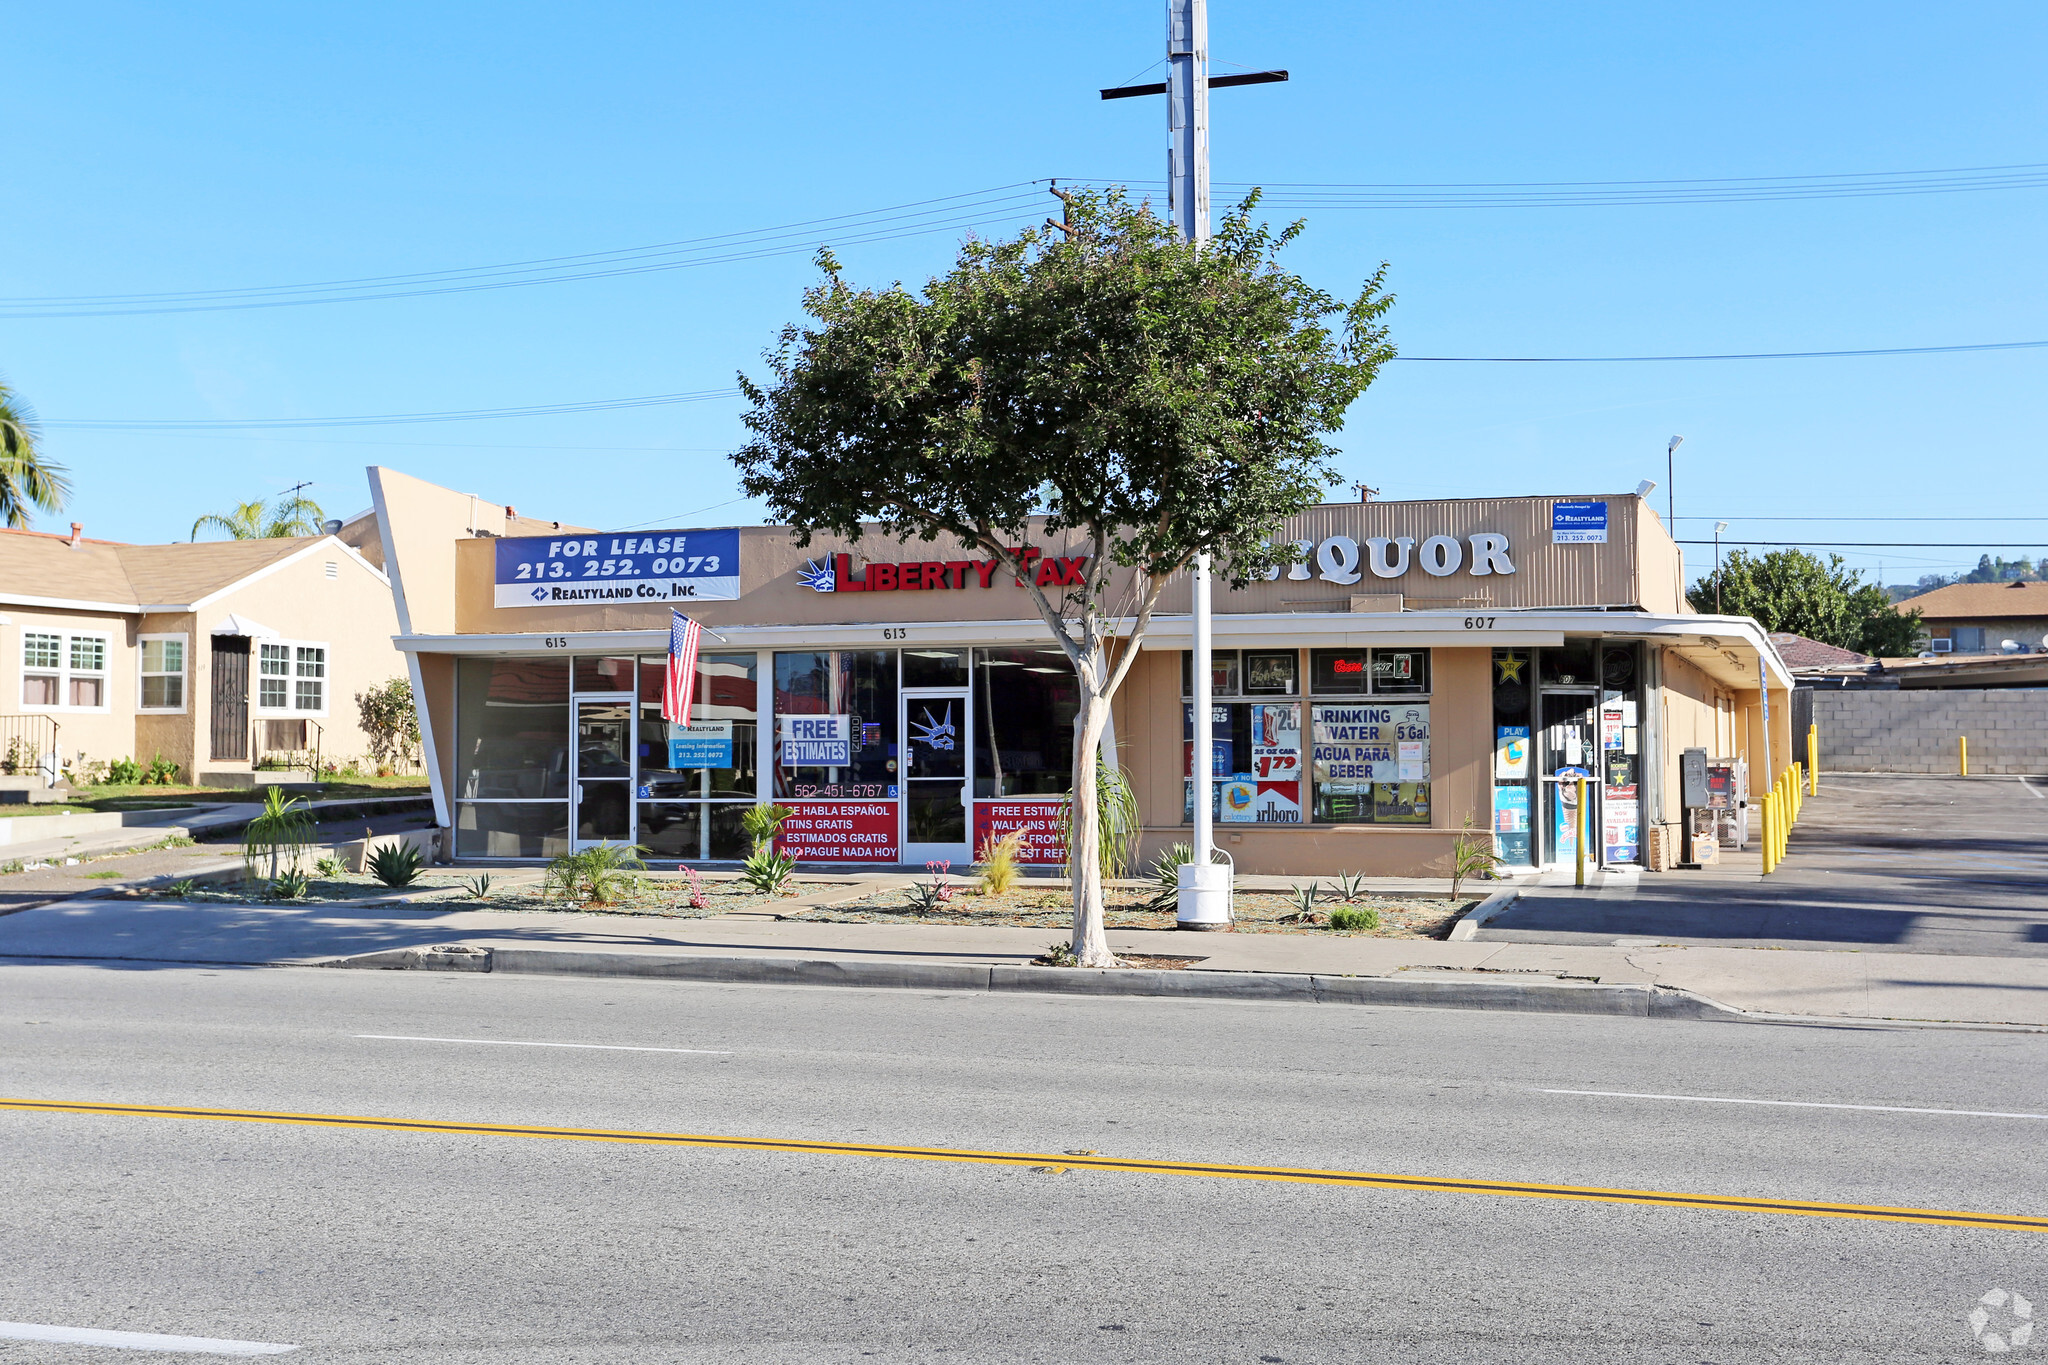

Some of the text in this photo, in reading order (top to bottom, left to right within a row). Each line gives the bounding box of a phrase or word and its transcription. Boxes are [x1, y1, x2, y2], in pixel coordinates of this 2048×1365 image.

[548, 536, 686, 558] FOR LEASE
[514, 556, 720, 579] 213. 252. 0073
[836, 552, 999, 592] LIBERTY
[1464, 617, 1496, 630] 607
[883, 629, 907, 640] 613
[545, 637, 567, 648] 615
[792, 720, 838, 738] FREE
[851, 717, 860, 750] OPEN
[1397, 725, 1429, 740] 5 Gal.
[1504, 727, 1524, 736] PLAY
[785, 741, 845, 760] ESTIMATES
[1314, 747, 1351, 762] AGUA
[1355, 748, 1391, 761] PARA
[1329, 764, 1373, 778] BEBER
[794, 785, 883, 798] 562-451-6767
[803, 806, 838, 816] HABLA
[841, 804, 890, 816] ESPAÑOL
[992, 806, 1020, 816] FREE
[1257, 801, 1299, 822] arlboro
[786, 820, 853, 829] ITINS GRATIS
[992, 820, 1045, 830] WALK-INS
[787, 833, 888, 843] ESTIMADOS GRATIS
[804, 847, 840, 856] PAGUE
[842, 847, 872, 857] NADA
[875, 847, 897, 857] HOY
